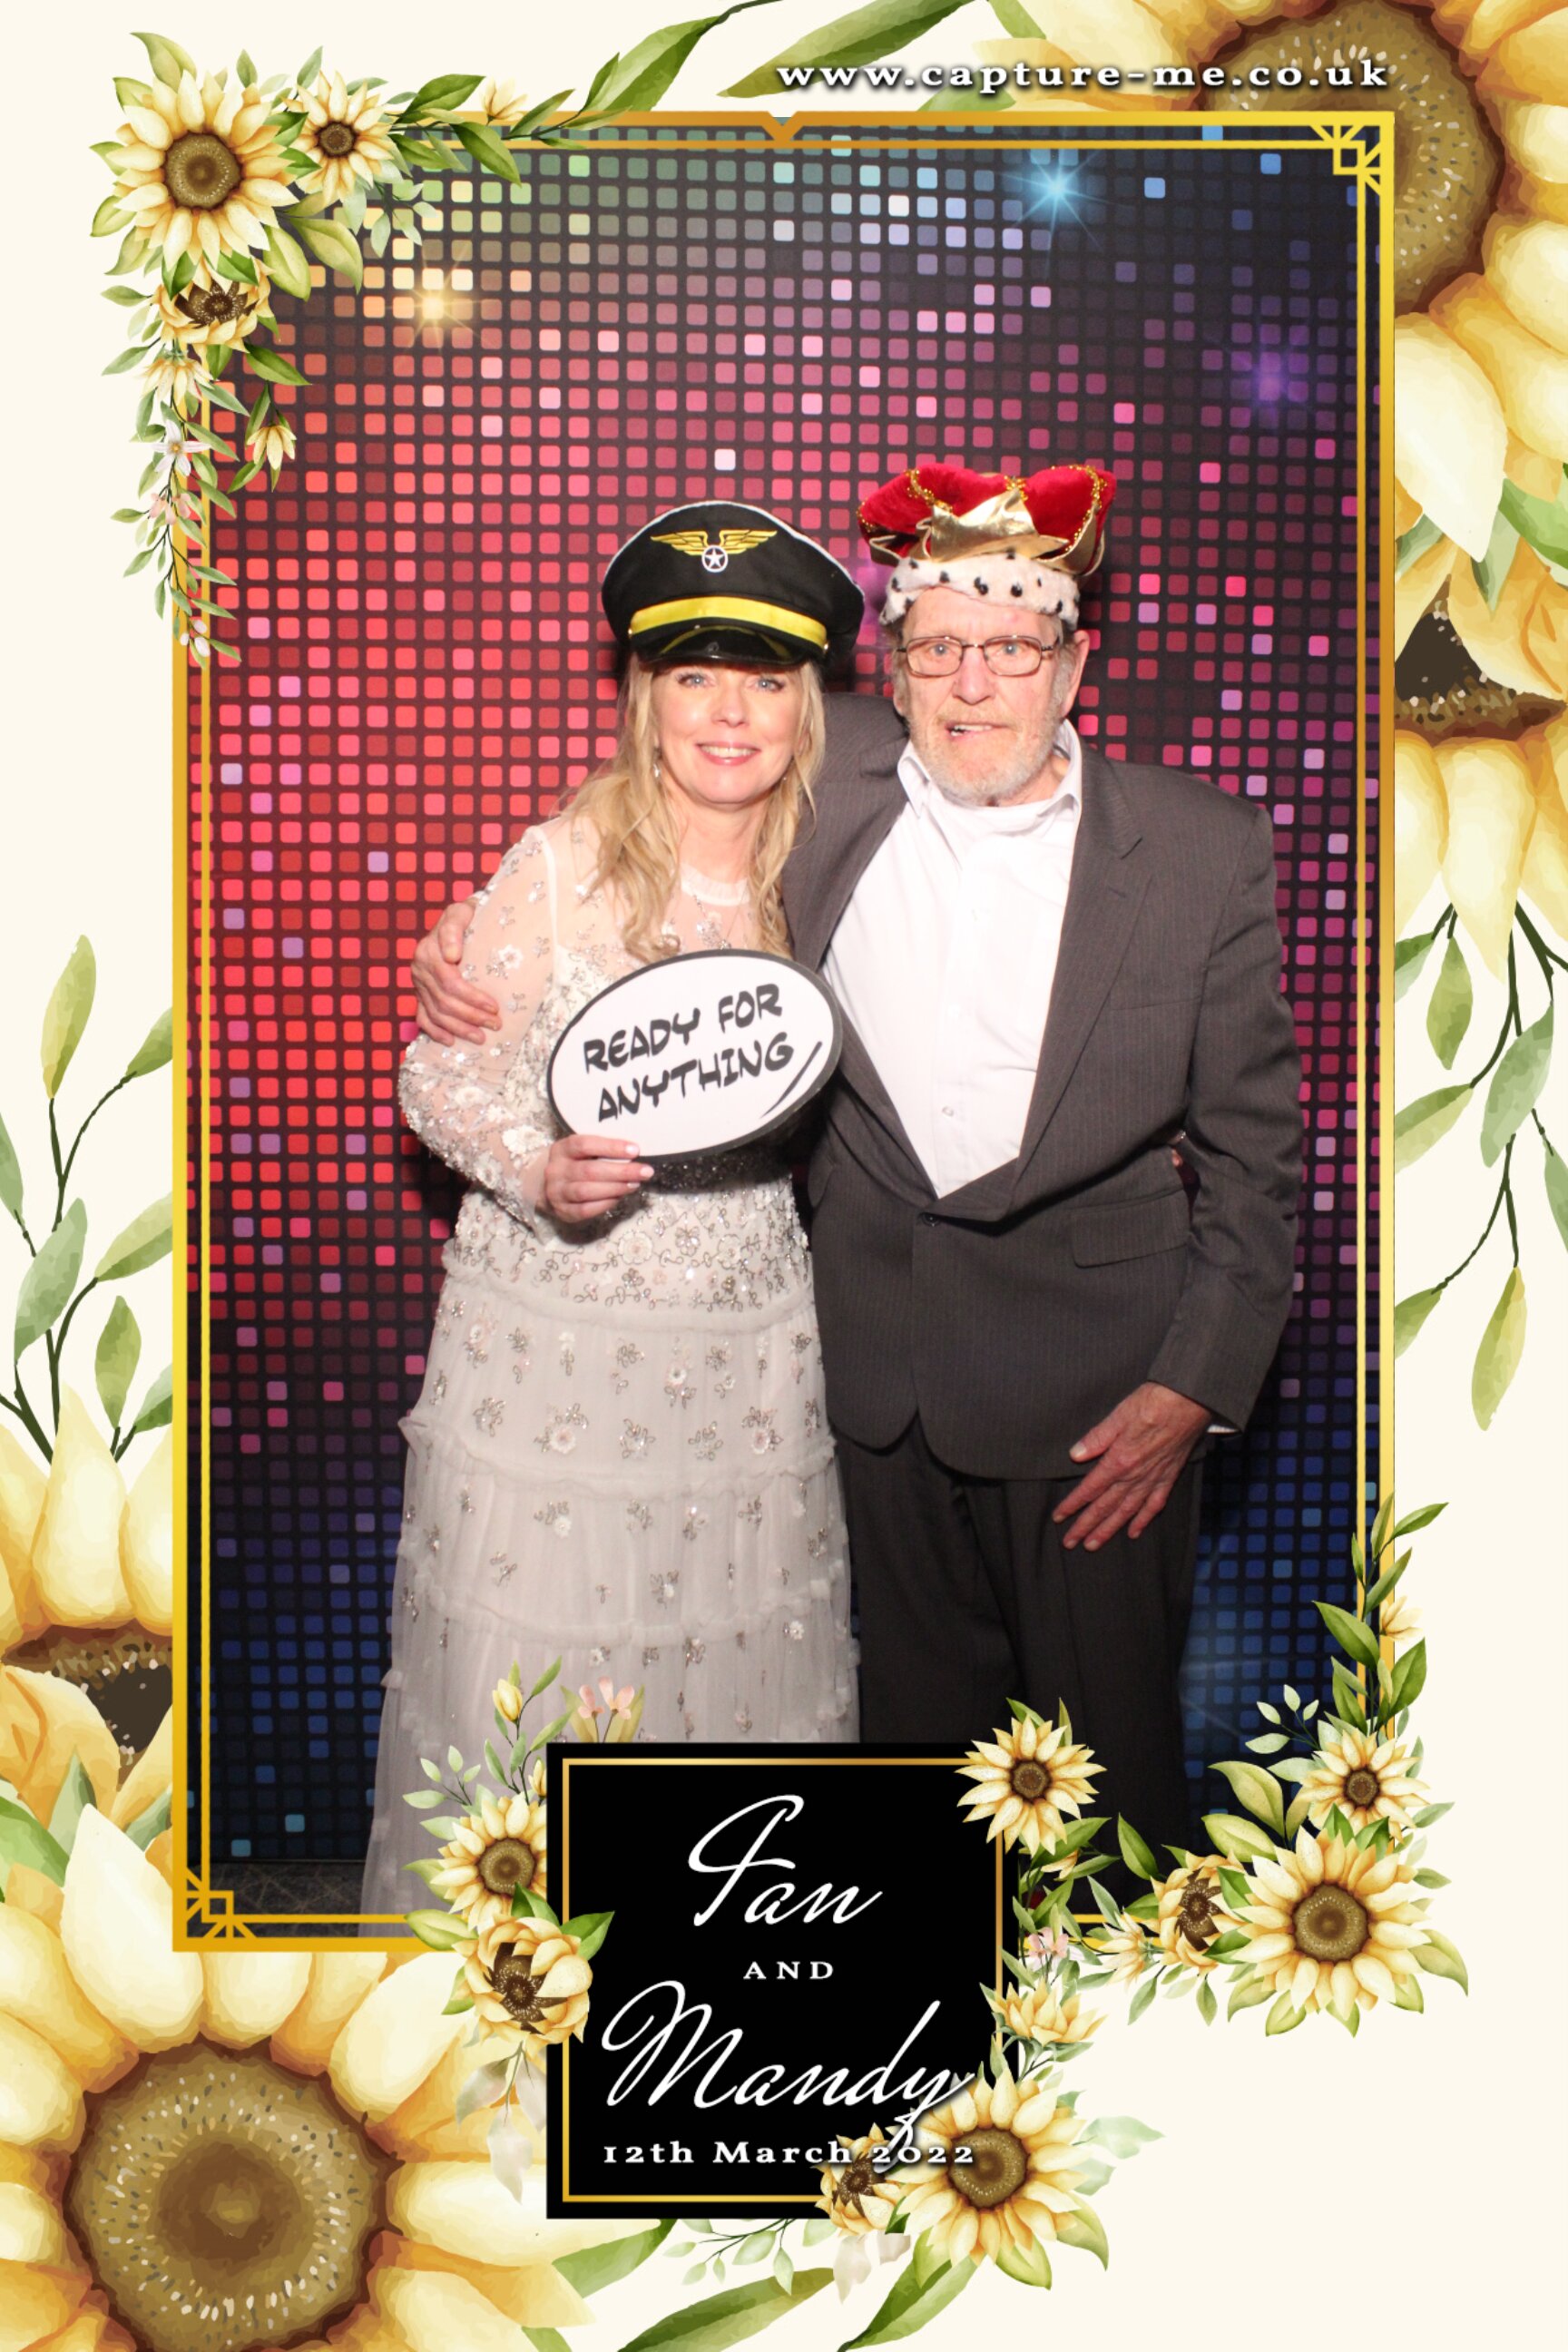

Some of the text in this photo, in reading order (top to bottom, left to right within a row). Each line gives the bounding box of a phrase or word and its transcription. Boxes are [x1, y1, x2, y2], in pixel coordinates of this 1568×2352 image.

[583, 983, 783, 1074] READY FOR
[598, 1031, 795, 1122] ANYTHING
